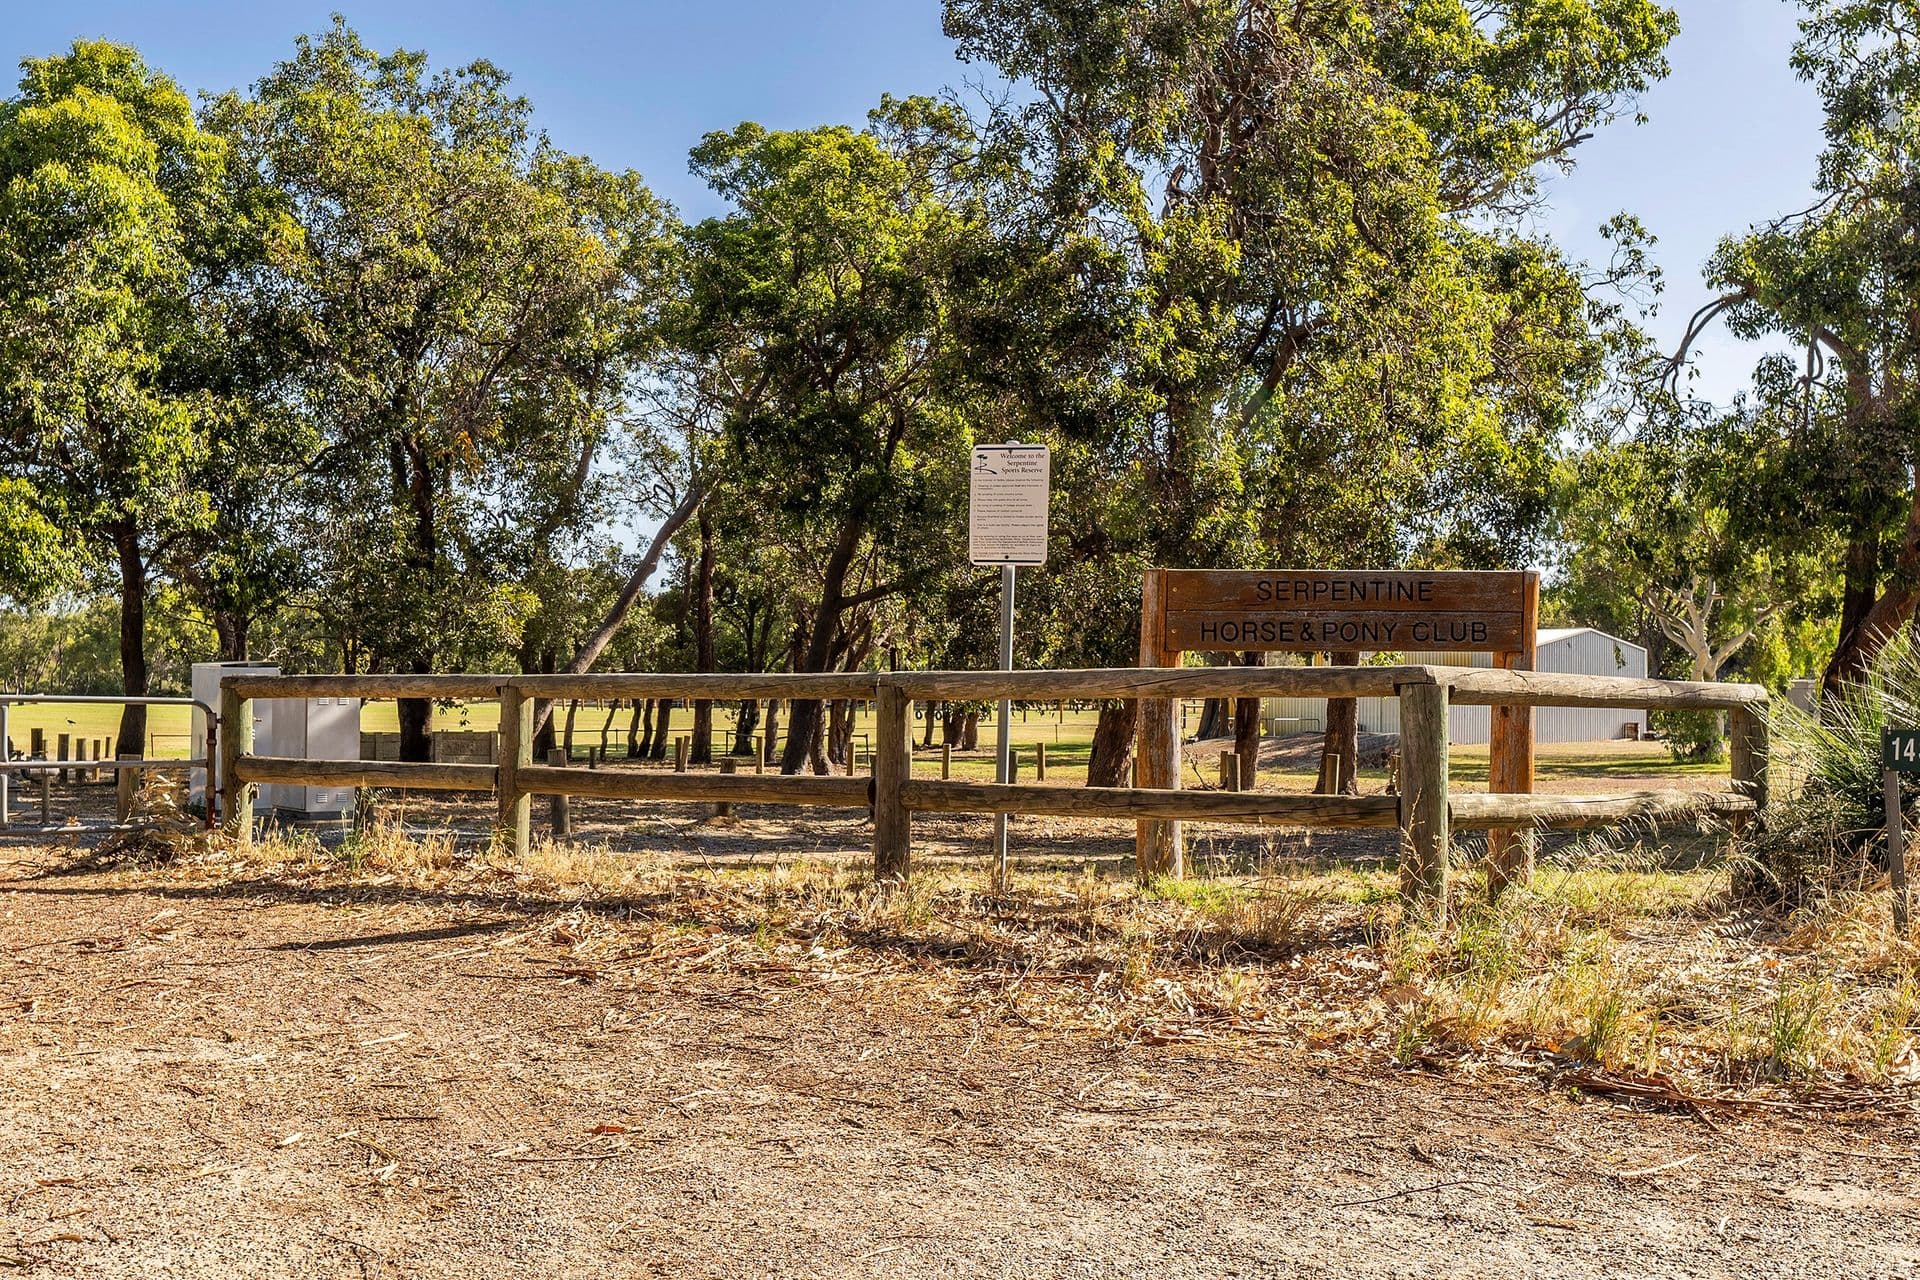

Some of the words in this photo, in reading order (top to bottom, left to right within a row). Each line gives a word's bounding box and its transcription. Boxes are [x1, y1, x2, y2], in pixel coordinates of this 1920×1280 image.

[1001, 467, 1020, 475] Sports
[1007, 460, 1038, 468] Serpentine
[1256, 580, 1434, 601] SERPENTINE
[1412, 621, 1488, 642] CLUB
[1891, 736, 1920, 762] 14
